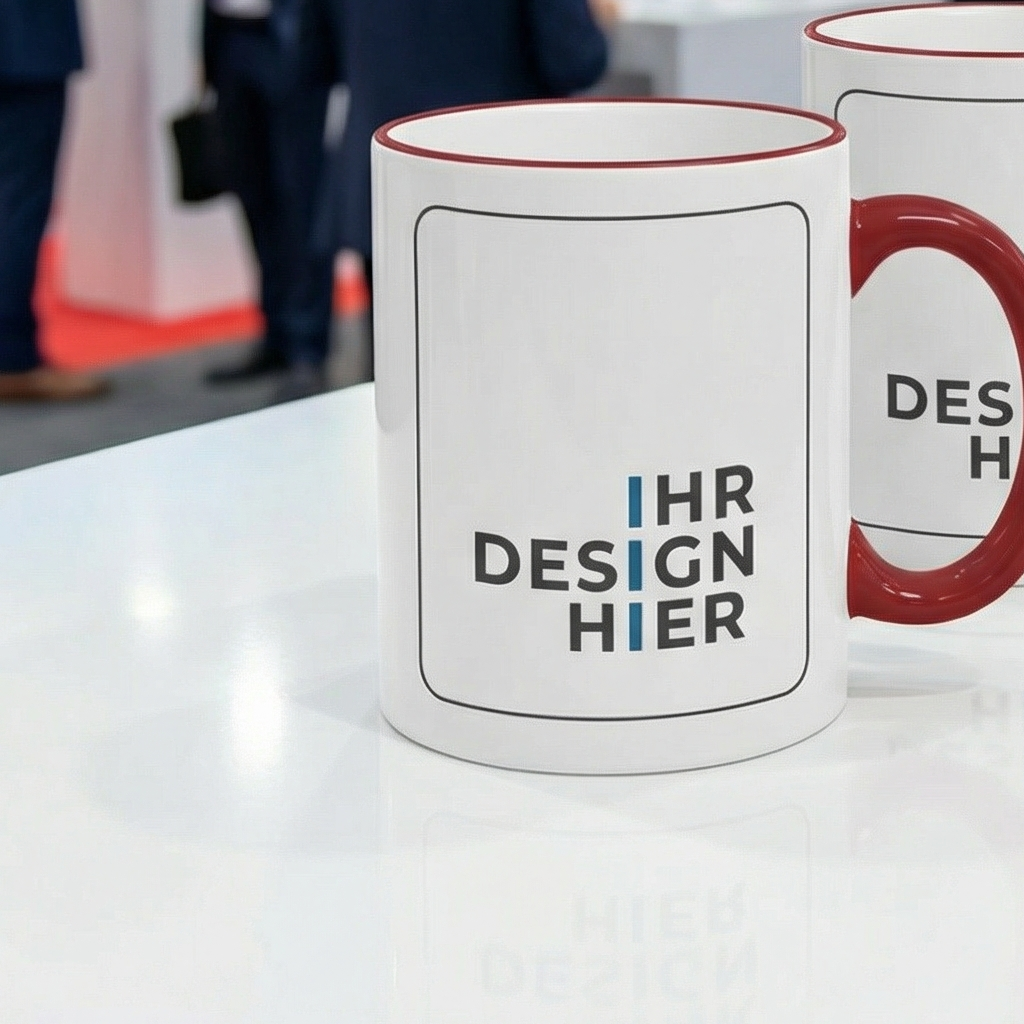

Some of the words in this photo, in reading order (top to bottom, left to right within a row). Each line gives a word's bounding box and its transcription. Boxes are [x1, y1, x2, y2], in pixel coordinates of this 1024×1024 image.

[628, 464, 755, 528] IHR
[475, 524, 755, 592] DESIGN
[569, 592, 746, 652] HIER
